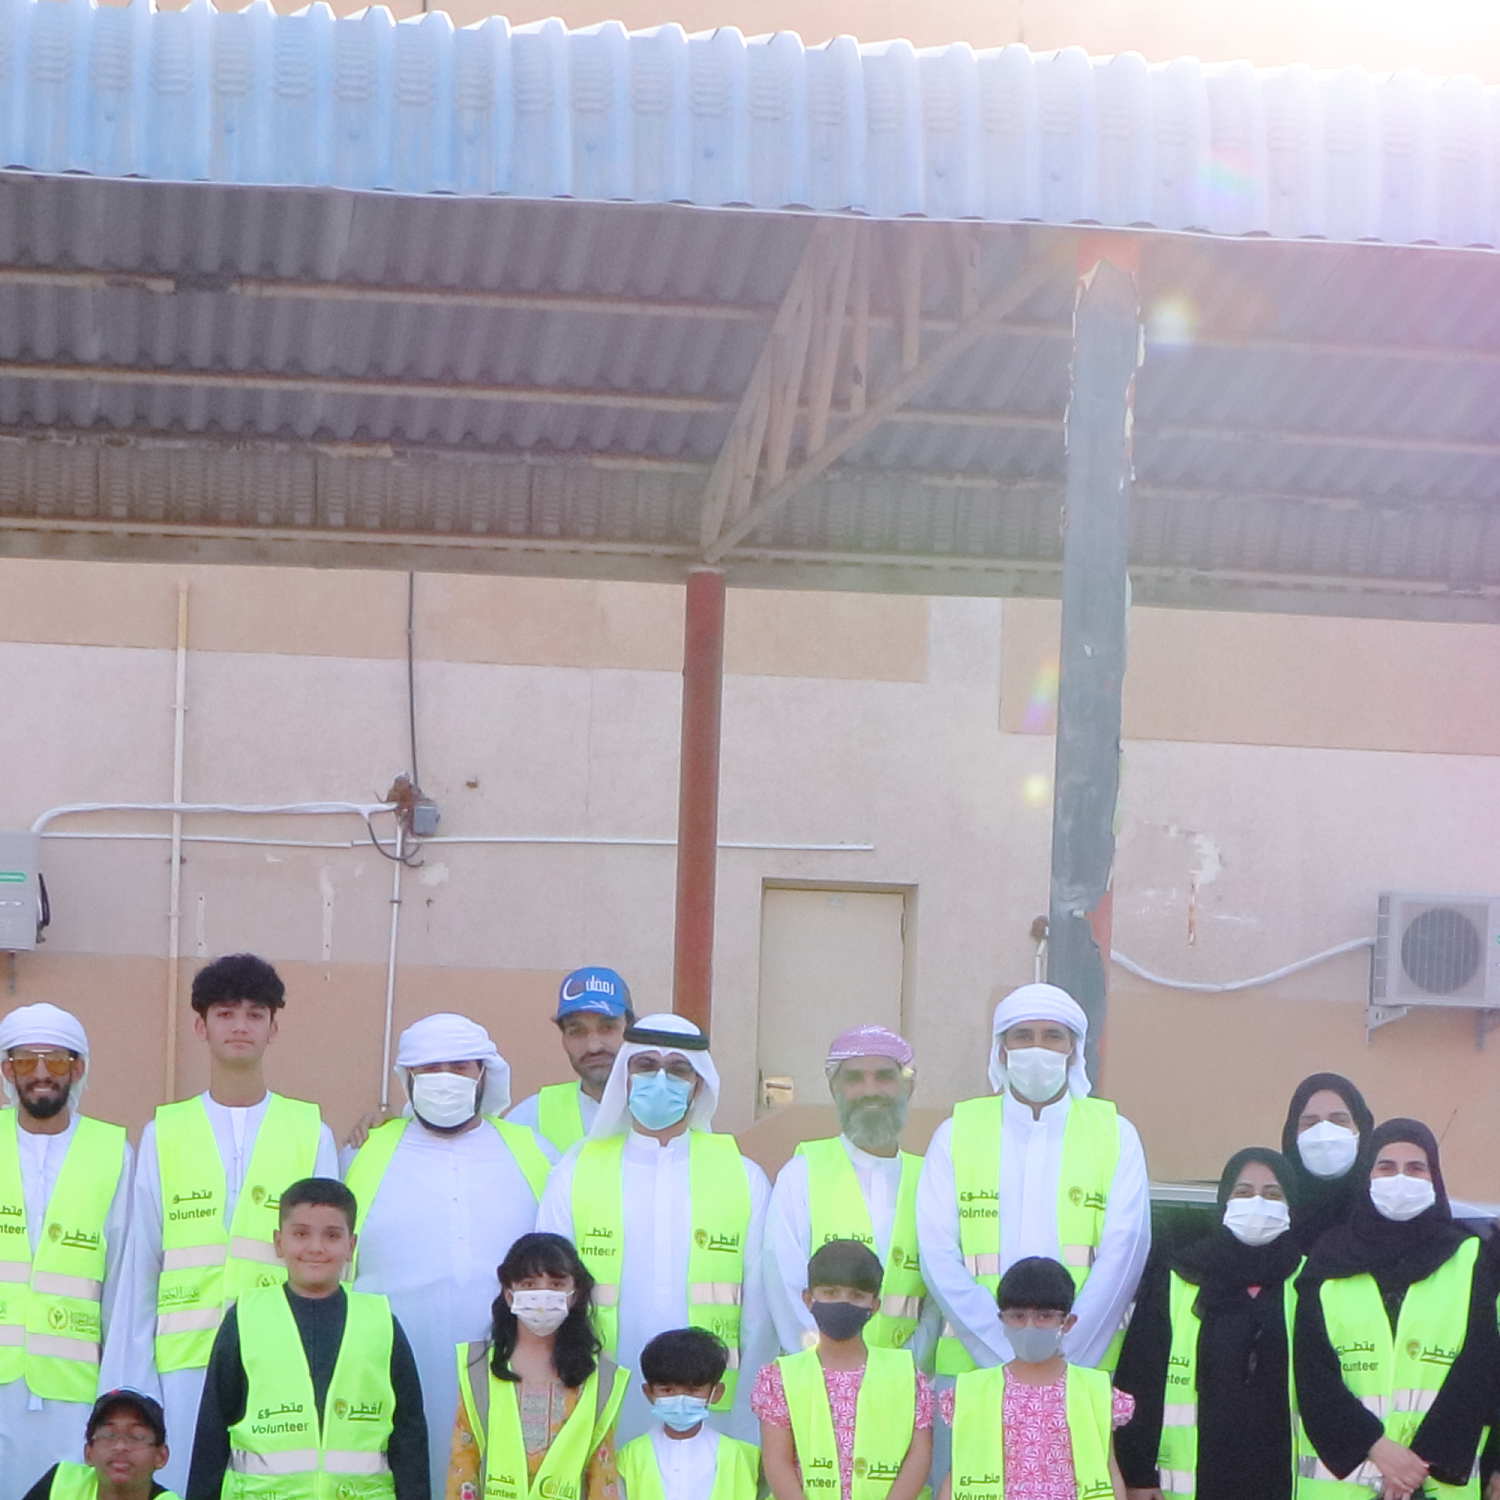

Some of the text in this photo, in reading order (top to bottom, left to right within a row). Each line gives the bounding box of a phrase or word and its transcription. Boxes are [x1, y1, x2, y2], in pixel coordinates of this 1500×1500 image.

[172, 1189, 213, 1204] متطو
[168, 1207, 217, 1221] olunteer
[257, 1402, 304, 1419] متطوع
[251, 1422, 310, 1434] Volunteer
[959, 1472, 1001, 1487] متطوع
